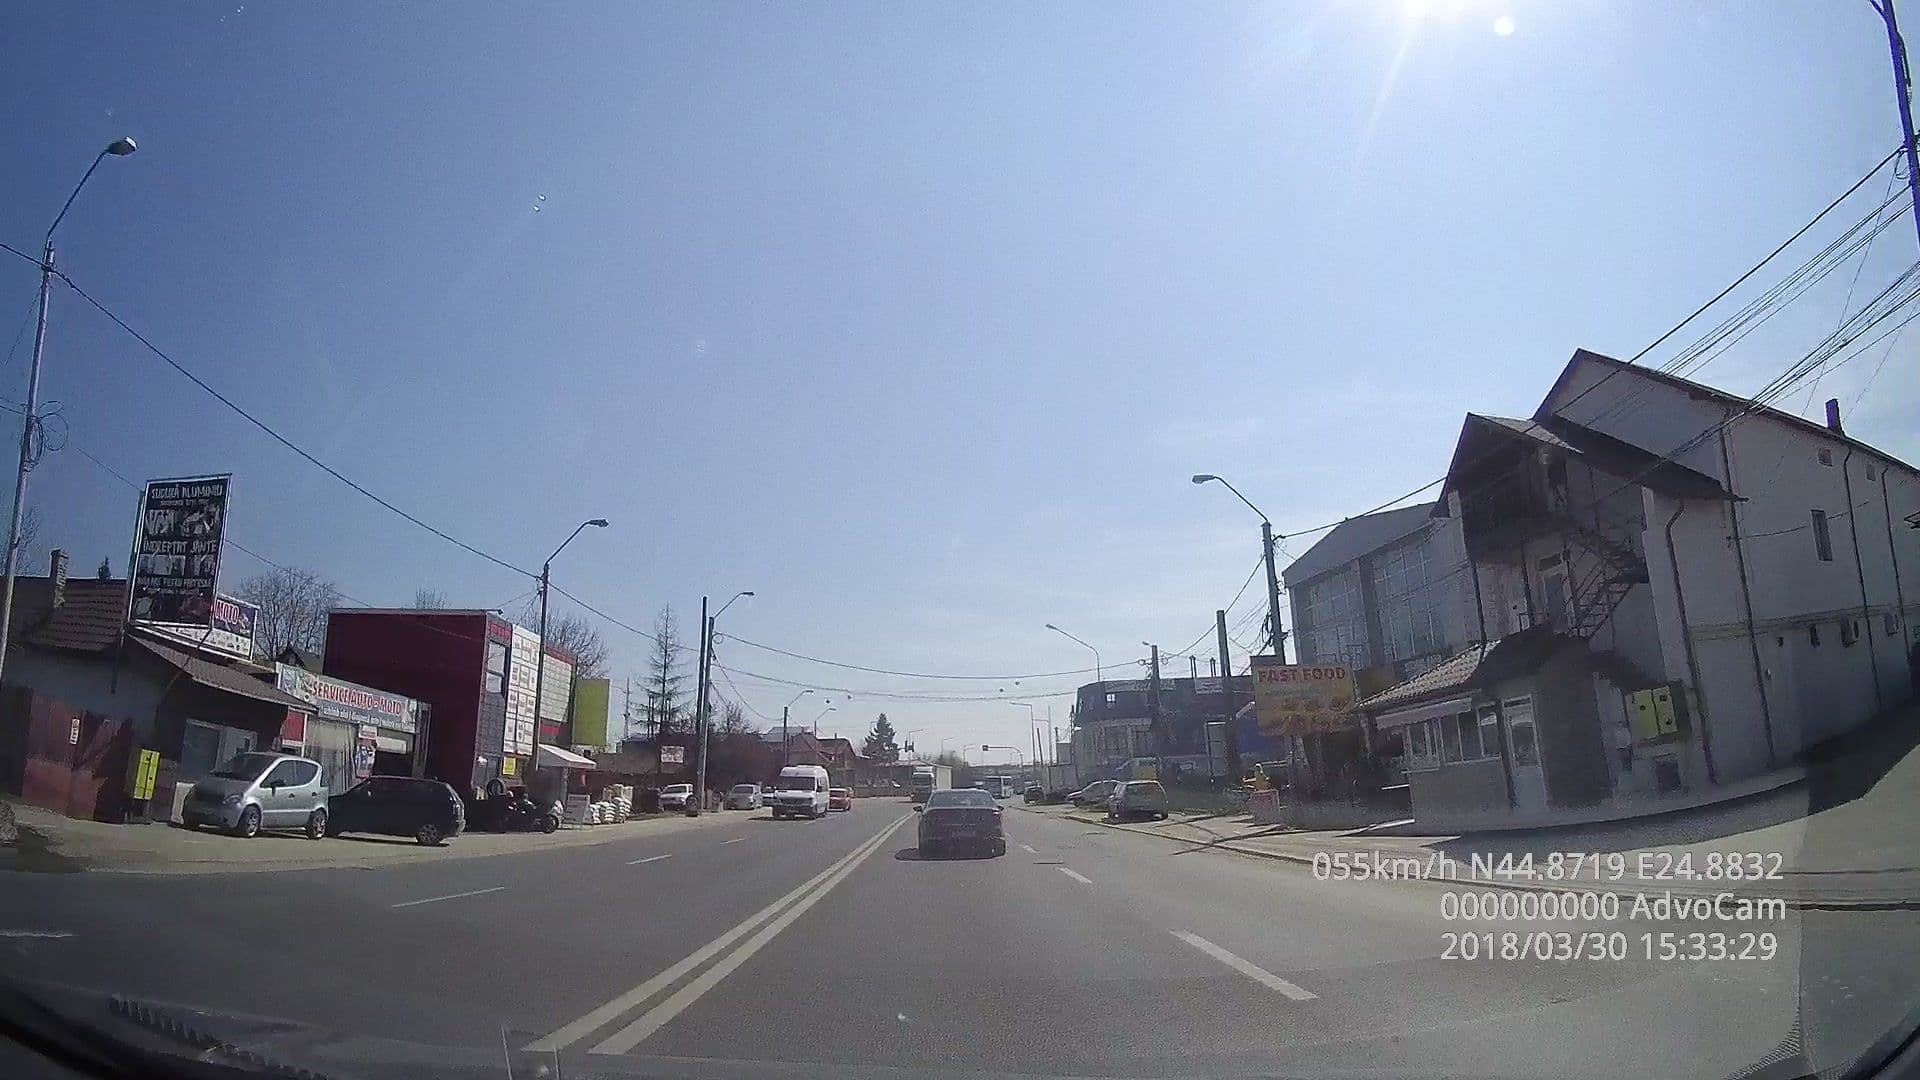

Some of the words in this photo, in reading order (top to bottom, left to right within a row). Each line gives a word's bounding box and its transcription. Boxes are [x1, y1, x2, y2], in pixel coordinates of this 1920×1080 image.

[181, 484, 223, 498] ALUMINIU
[190, 539, 217, 553] JANTE
[215, 600, 240, 624] MOTO
[1257, 668, 1297, 682] FAST
[1302, 666, 1346, 680] FOOD
[311, 679, 350, 704] SERVICE
[350, 690, 373, 710] AUTO
[379, 695, 402, 716] MOTO
